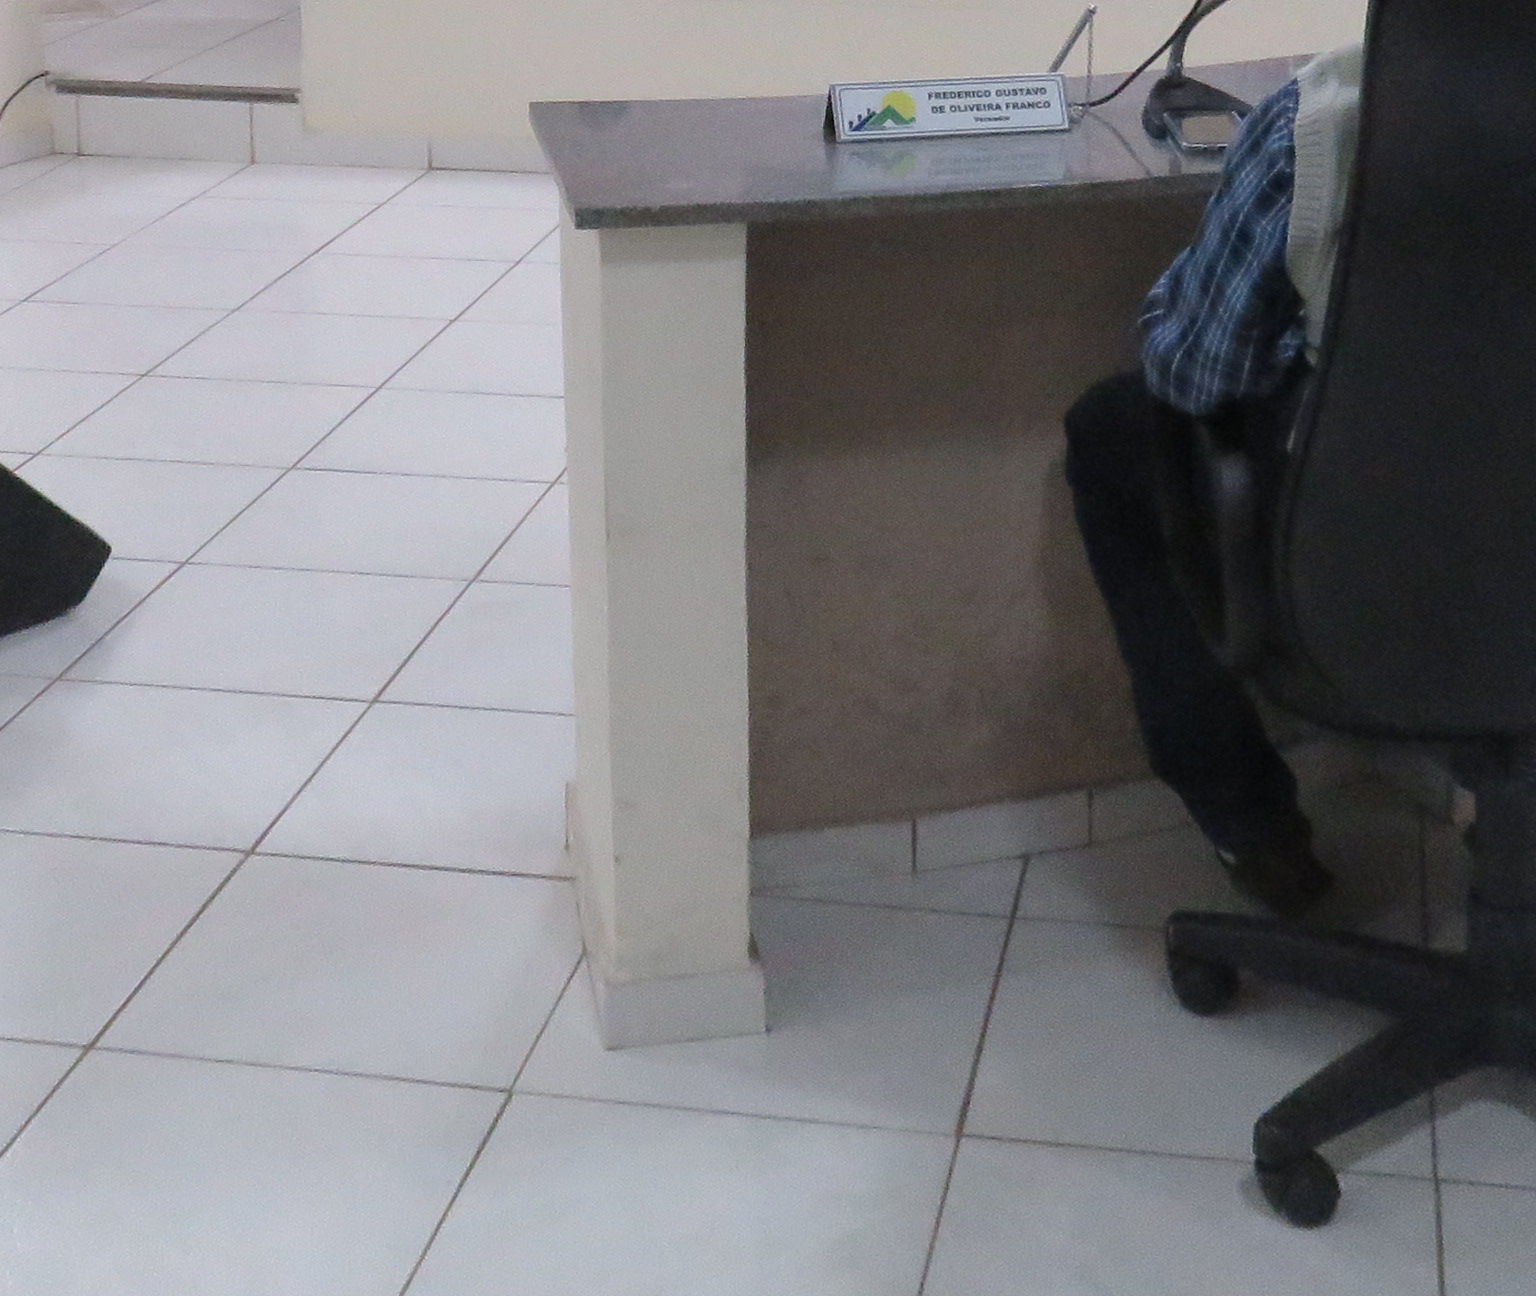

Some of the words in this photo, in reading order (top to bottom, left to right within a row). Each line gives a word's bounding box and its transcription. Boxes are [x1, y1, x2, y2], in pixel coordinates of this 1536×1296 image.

[927, 89, 991, 101] FREDERICO
[996, 86, 1048, 98] GUSTAVO
[931, 104, 946, 114] DE
[949, 102, 1002, 114] OLIVEIRA
[1005, 100, 1051, 111] FRANCO
